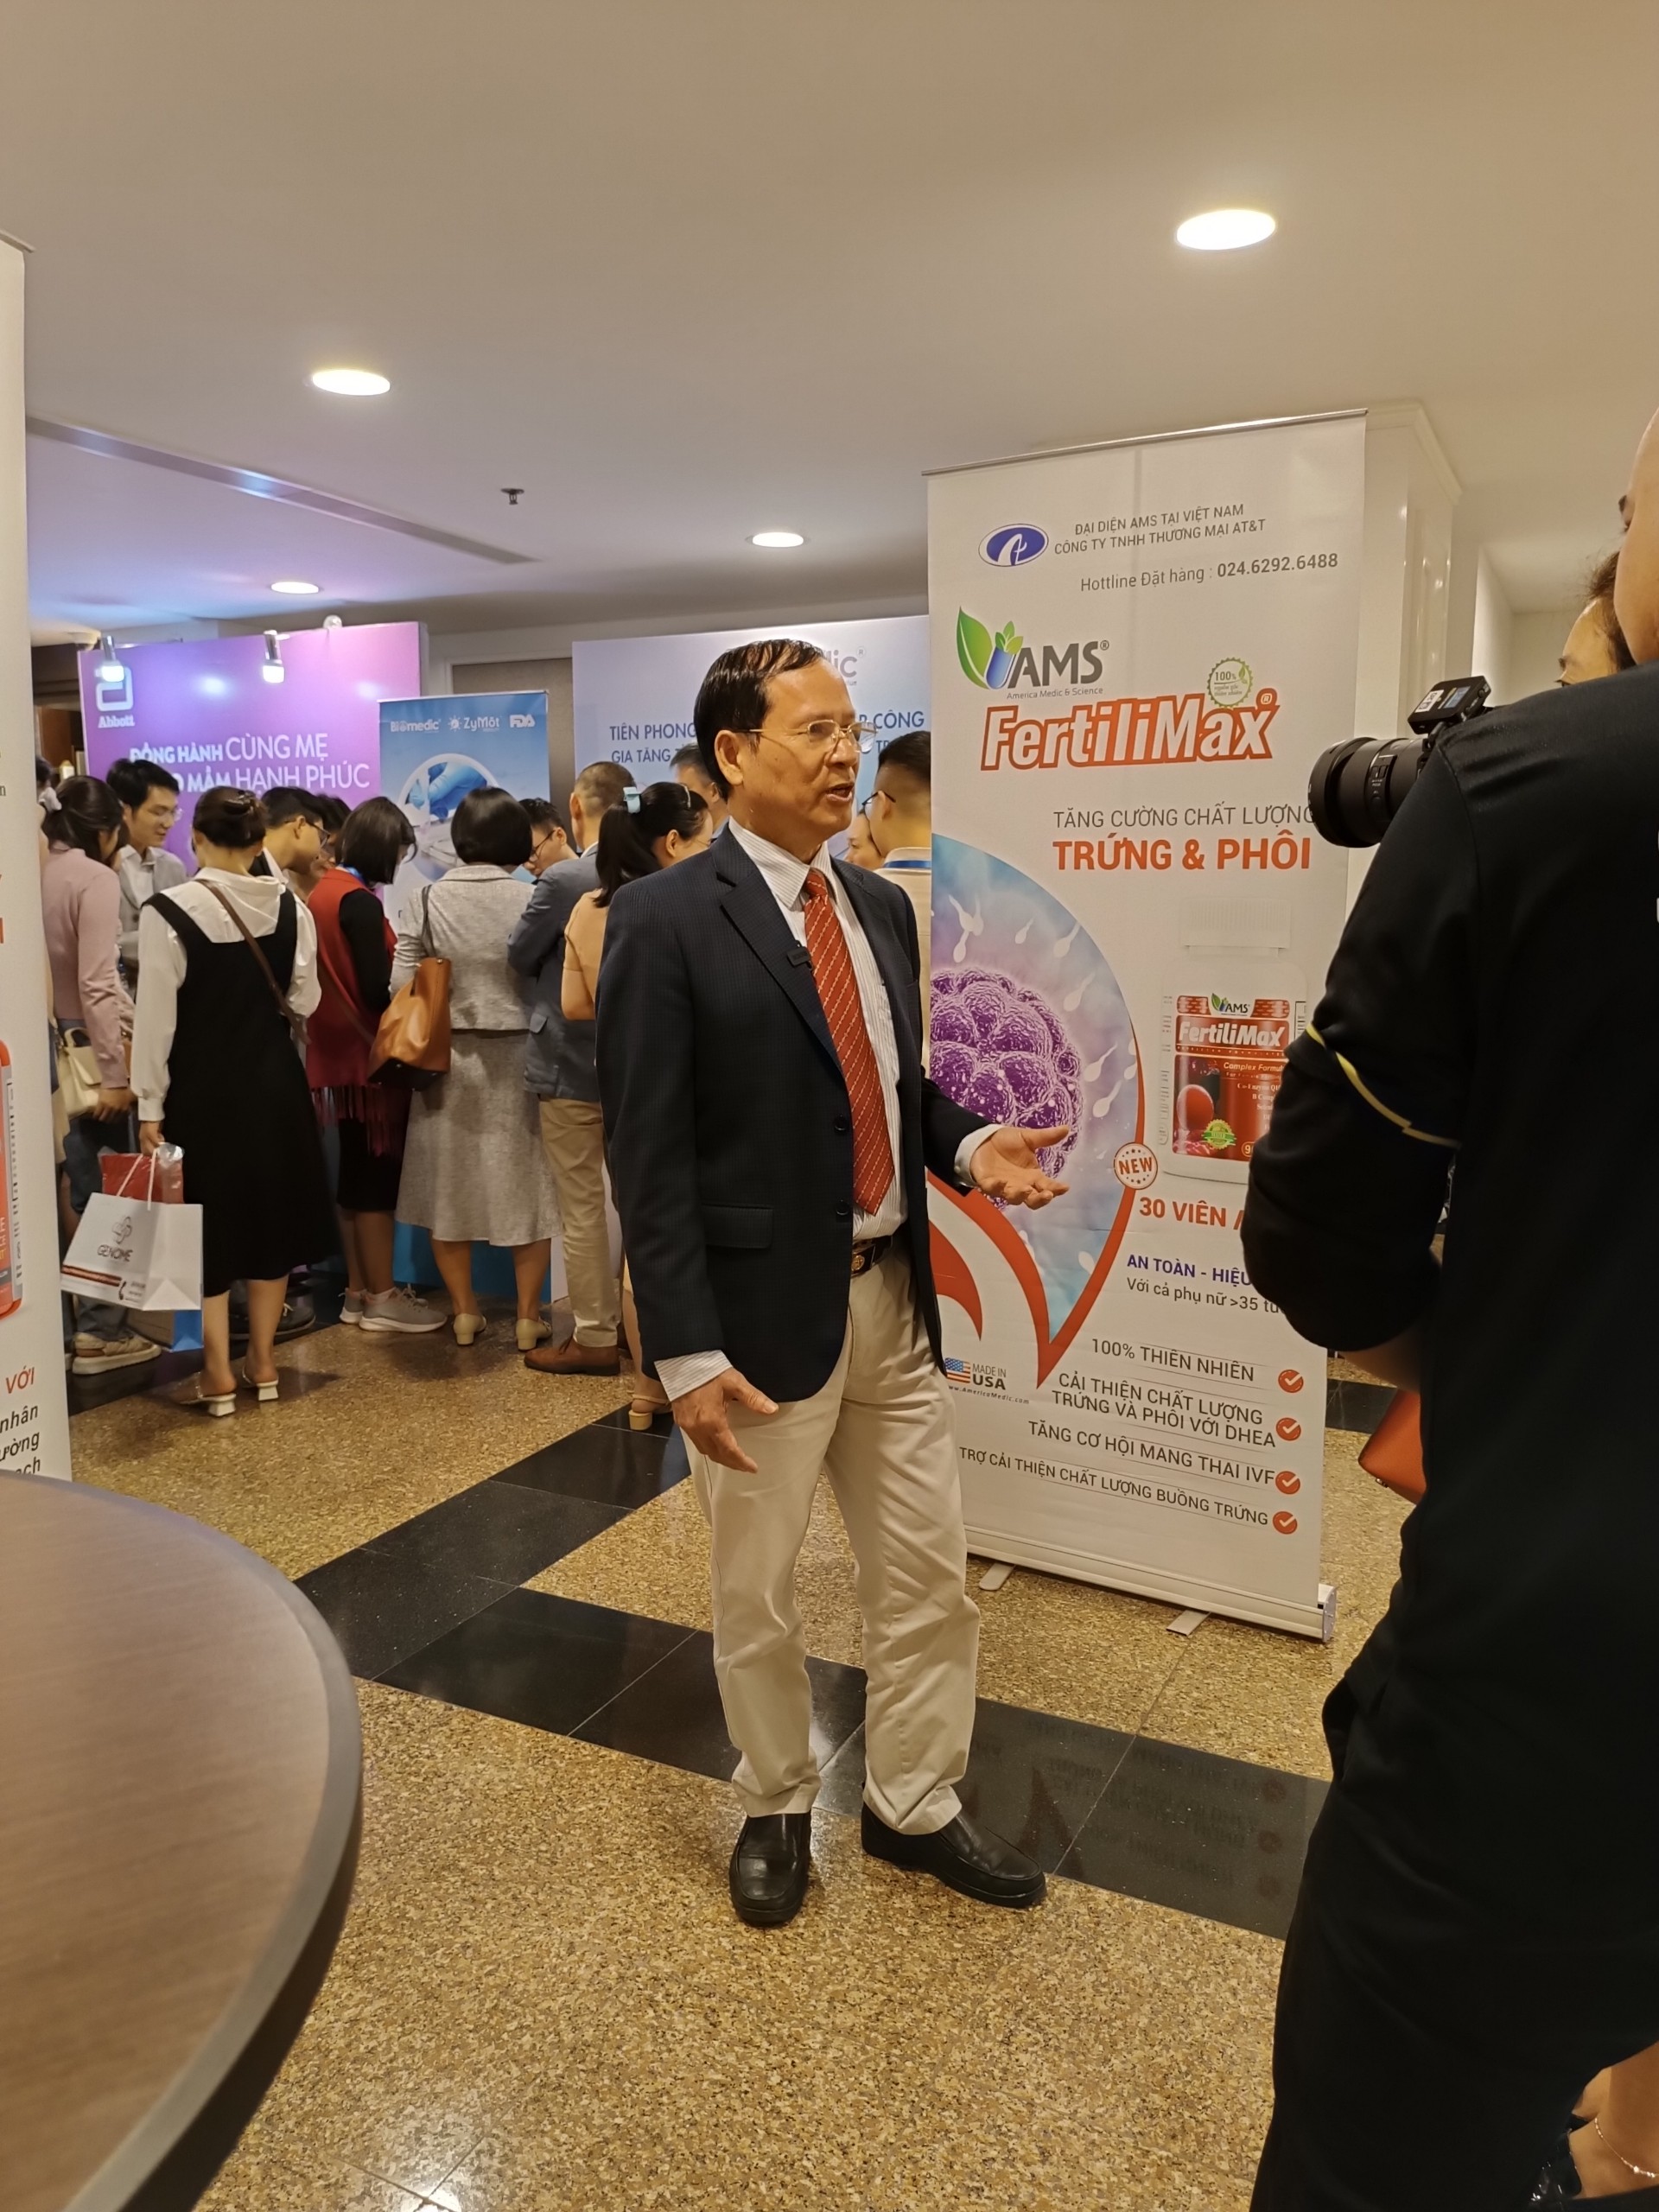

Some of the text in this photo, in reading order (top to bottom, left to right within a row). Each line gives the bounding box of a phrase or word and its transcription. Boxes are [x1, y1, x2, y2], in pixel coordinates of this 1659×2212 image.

[1075, 504, 1244, 537] ĐẠI DIỆN AMS TẠI VIỆT NAM
[1054, 518, 1266, 555] CÔNG TY TNHH THƯƠNG MẠI AT&T
[1080, 574, 1137, 592] Hottline
[1141, 570, 1166, 588] Đặt
[1169, 566, 1205, 584] hàng
[1217, 552, 1338, 578] 024.6292.6488
[1007, 640, 1103, 690] AMS
[1007, 691, 1038, 700] America
[1039, 689, 1063, 698] Medic
[1072, 686, 1103, 696] Science
[98, 715, 135, 729] Abbott
[509, 714, 536, 728] FDA
[609, 722, 639, 741] TIÊN
[873, 709, 925, 729] CÔNG
[980, 692, 1280, 772] FertiliMax
[177, 741, 223, 763] HÀNH
[225, 733, 291, 761] CÙNG
[295, 732, 329, 761] MẸ
[611, 749, 633, 764] GIA
[636, 747, 671, 763] TĂNG
[235, 765, 301, 796] HẠNH
[306, 760, 371, 789] PHÚC
[1053, 807, 1104, 828] TĂNG
[1110, 804, 1178, 828] CƯỜNG
[1184, 800, 1236, 825] CHẤT
[1052, 829, 1311, 871] TRỨNG & PHÔI
[1224, 1003, 1249, 1014] AMS
[1223, 1061, 1256, 1071] Complex
[1118, 1156, 1153, 1175] NEW
[1139, 1196, 1166, 1218] 30
[1172, 1199, 1226, 1228] VIÊN
[1127, 1254, 1149, 1270] AN
[1153, 1257, 1196, 1278] TOÀN
[1127, 1276, 1149, 1293] Với
[1154, 1281, 1170, 1297] cả
[1174, 1287, 1201, 1305] phụ
[1206, 1292, 1227, 1306] nữ
[1230, 1295, 1258, 1311] >35
[972, 1363, 1007, 1378] MADE IN
[1092, 1338, 1254, 1382] 100% THIÊN NHIÊN
[6, 1365, 35, 1394] VỚI
[948, 1384, 1029, 1405] ww.AmericaMedic.com
[972, 1374, 1006, 1390] USA
[1058, 1370, 1262, 1425] CẢI THIỆN CHẤT LƯỢNG
[1052, 1389, 1275, 1447] TRỨNG VÀ PHÔI VỚI DHEA
[1028, 1420, 1274, 1486] TĂNG CƠ HỘI MANG THAI IVF
[959, 1446, 1268, 1526] TRỢ CẢI THIỆN CHẤT LƯỢNG BUỒNG TRỨNG
